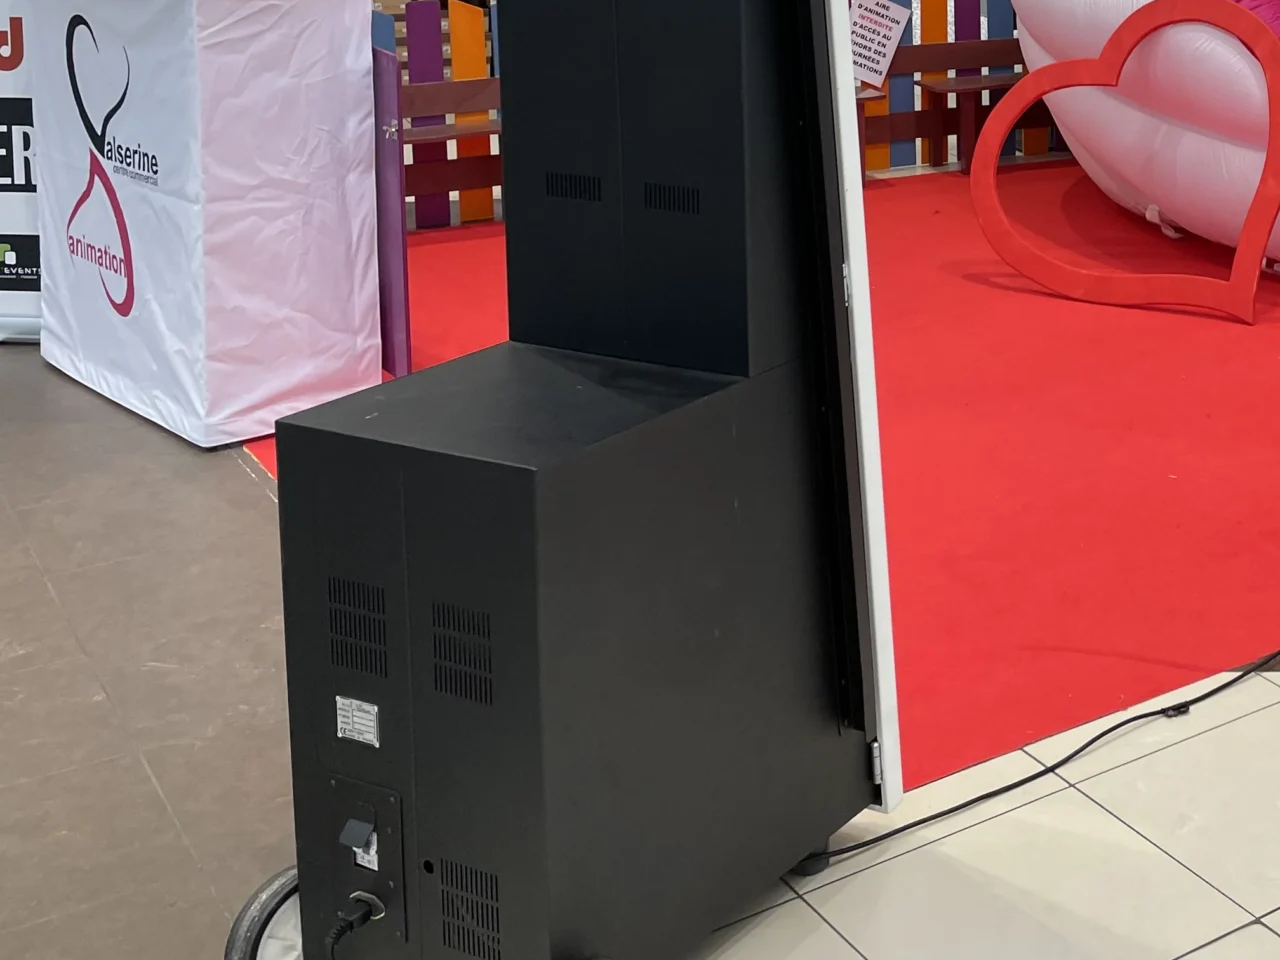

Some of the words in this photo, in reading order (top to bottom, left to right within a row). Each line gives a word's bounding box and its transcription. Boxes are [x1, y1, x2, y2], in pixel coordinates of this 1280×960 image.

[857, 3, 900, 26] D'ANIMATION
[874, 1, 891, 12] AIRE
[858, 13, 893, 32] INTERDITE
[851, 29, 876, 45] PUBLIC
[877, 40, 887, 49] EN
[881, 33, 892, 42] AU
[852, 40, 872, 53] HORS
[873, 48, 887, 59] DES
[68, 234, 127, 278] animation
